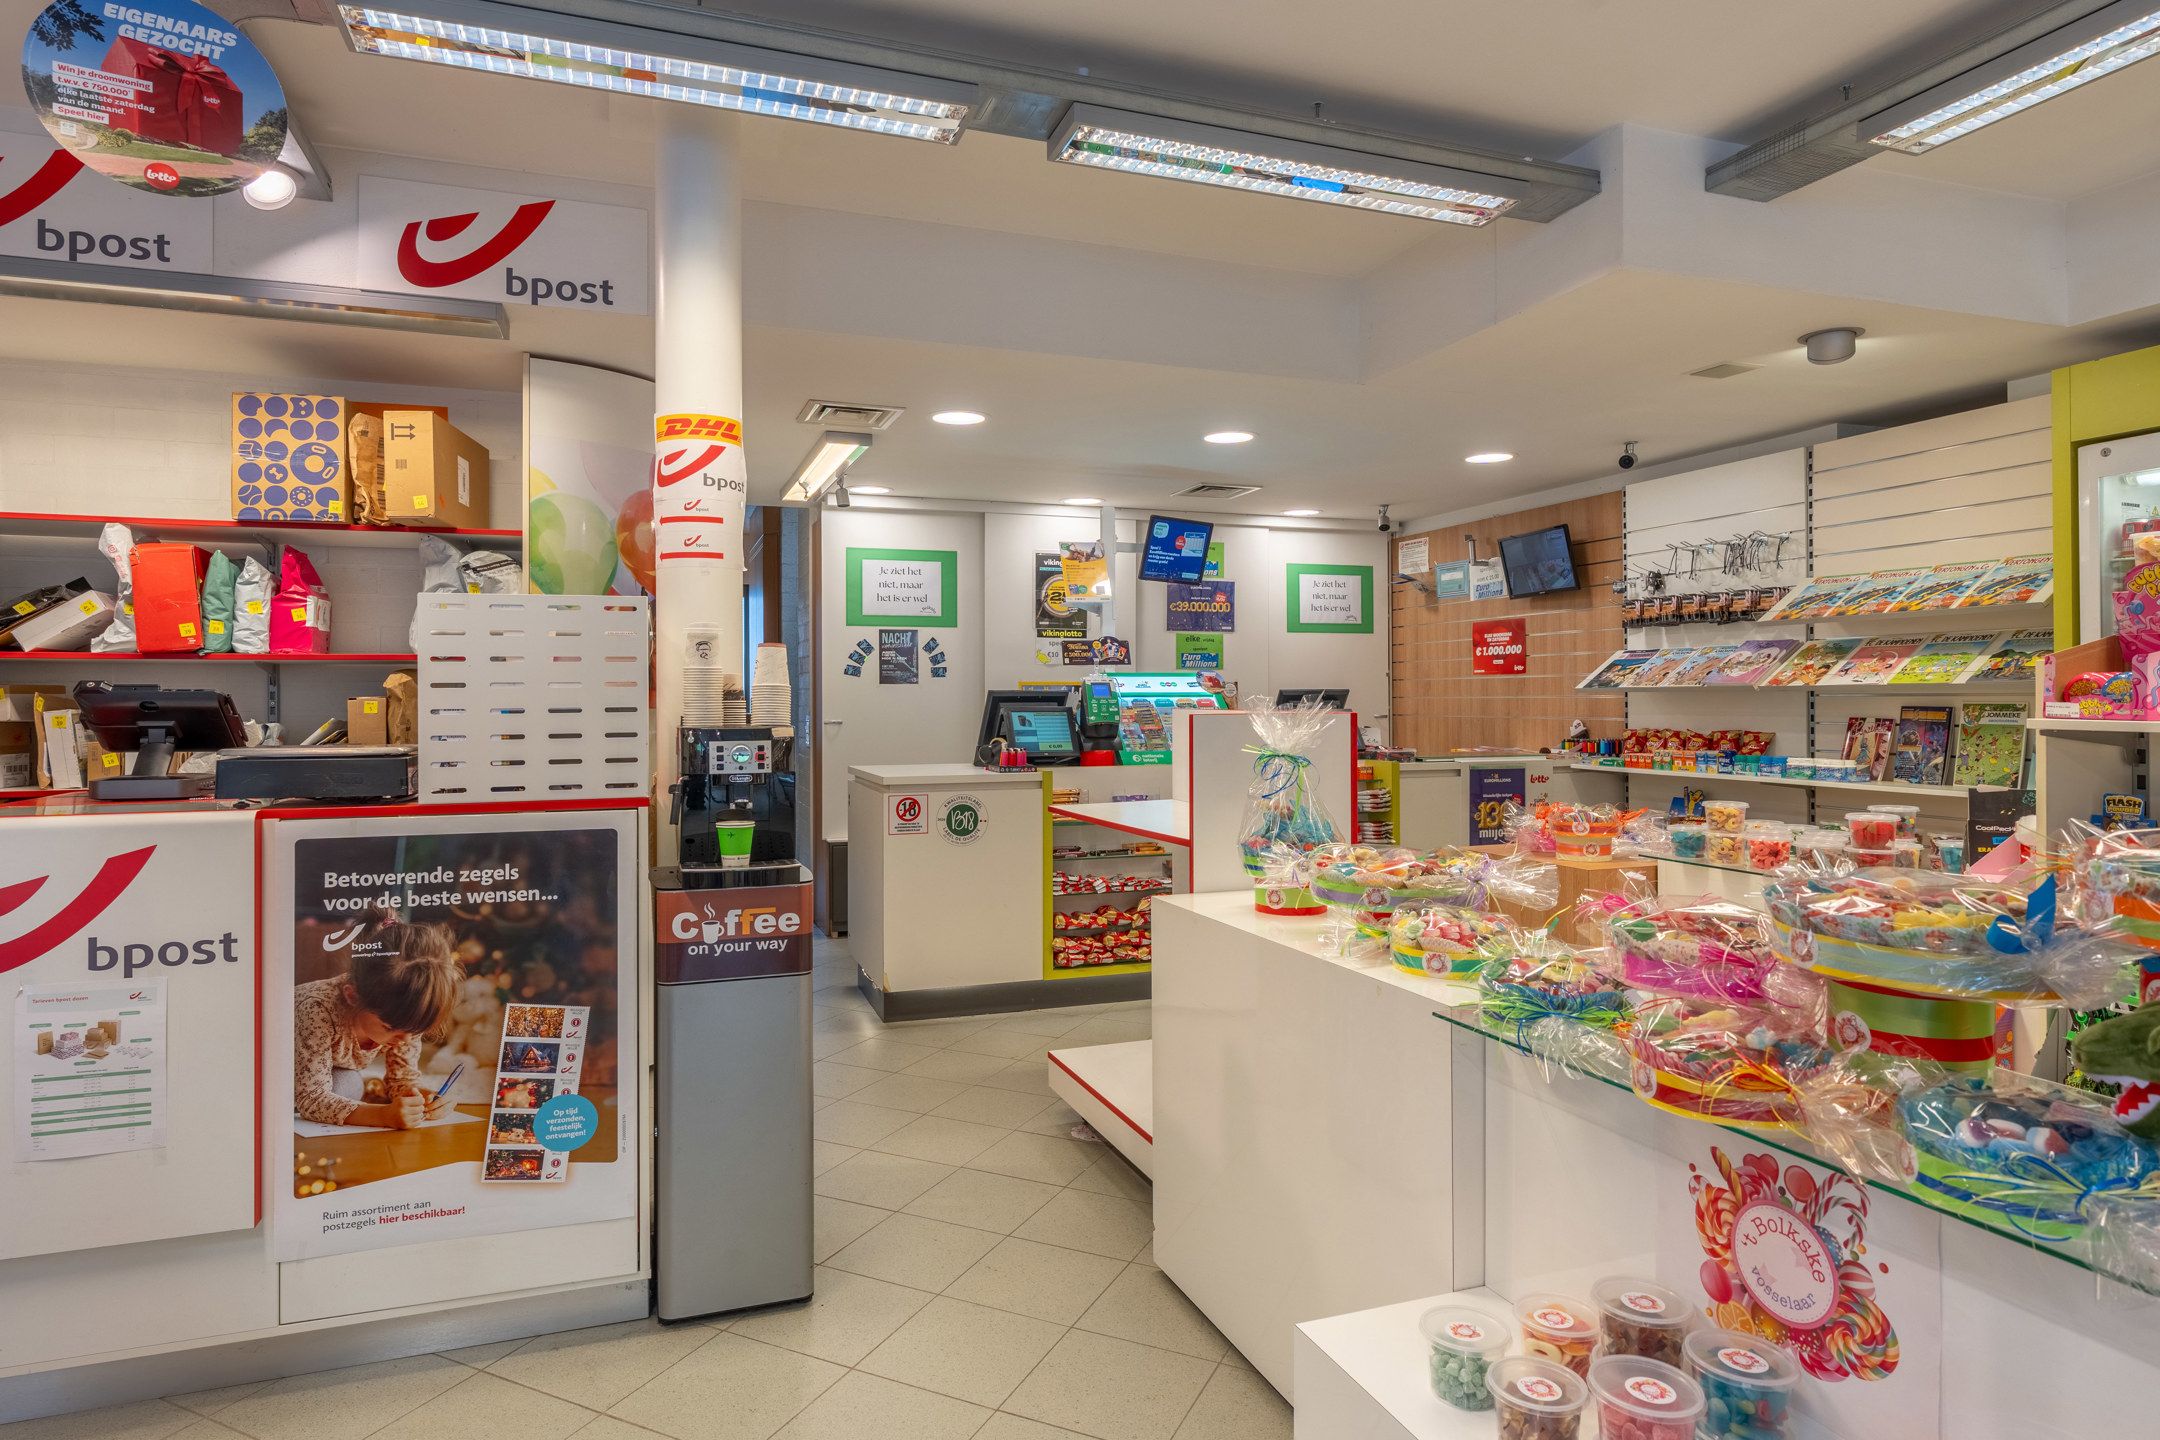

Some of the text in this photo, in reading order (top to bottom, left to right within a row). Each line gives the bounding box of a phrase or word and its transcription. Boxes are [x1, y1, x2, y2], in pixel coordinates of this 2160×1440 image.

[103, 3, 238, 47] EIGENAARS
[117, 24, 224, 60] GEZOCHT
[58, 63, 151, 91] Win je droomwoning
[58, 76, 80, 86] t.w.v.
[57, 87, 155, 114] elke laatste zaterdag
[58, 96, 126, 115] van de maand.
[58, 106, 105, 121] Speel hier
[37, 219, 171, 263] bpost
[505, 267, 614, 306] bpost
[664, 418, 740, 441] DHL
[703, 472, 745, 494] bpost
[878, 567, 922, 576] Je ziet het
[878, 581, 898, 589] niet,
[1312, 580, 1346, 588] Je ziet het
[876, 593, 928, 603] het is er wel
[1170, 601, 1231, 613] €39.000.000
[1310, 603, 1323, 611] het
[1339, 604, 1351, 612] wel
[1042, 629, 1083, 638] vikinglotto
[1185, 635, 1200, 643] elke
[1476, 645, 1522, 656] € 1.000.000
[1185, 660, 1217, 668] Millions
[1985, 711, 2022, 719] JOMMEKE
[2106, 798, 2142, 808] FLASH
[324, 863, 519, 888] Betoverende zegels
[324, 887, 558, 911] voor de beste wensen...
[351, 941, 382, 951] bpost
[688, 939, 788, 957] on your way
[88, 932, 238, 979] bpost
[553, 1107, 578, 1118] Op tijd
[546, 1114, 586, 1125] verzonden,
[545, 1130, 587, 1140] ontvangen!
[549, 1123, 583, 1134] feestelijk
[322, 1201, 431, 1220] Ruim assortiment aan
[322, 1206, 466, 1233] postzegels hier beschikbaar!
[1750, 1216, 1826, 1284] Bolkske
[1751, 1266, 1816, 1311] vosselaar
